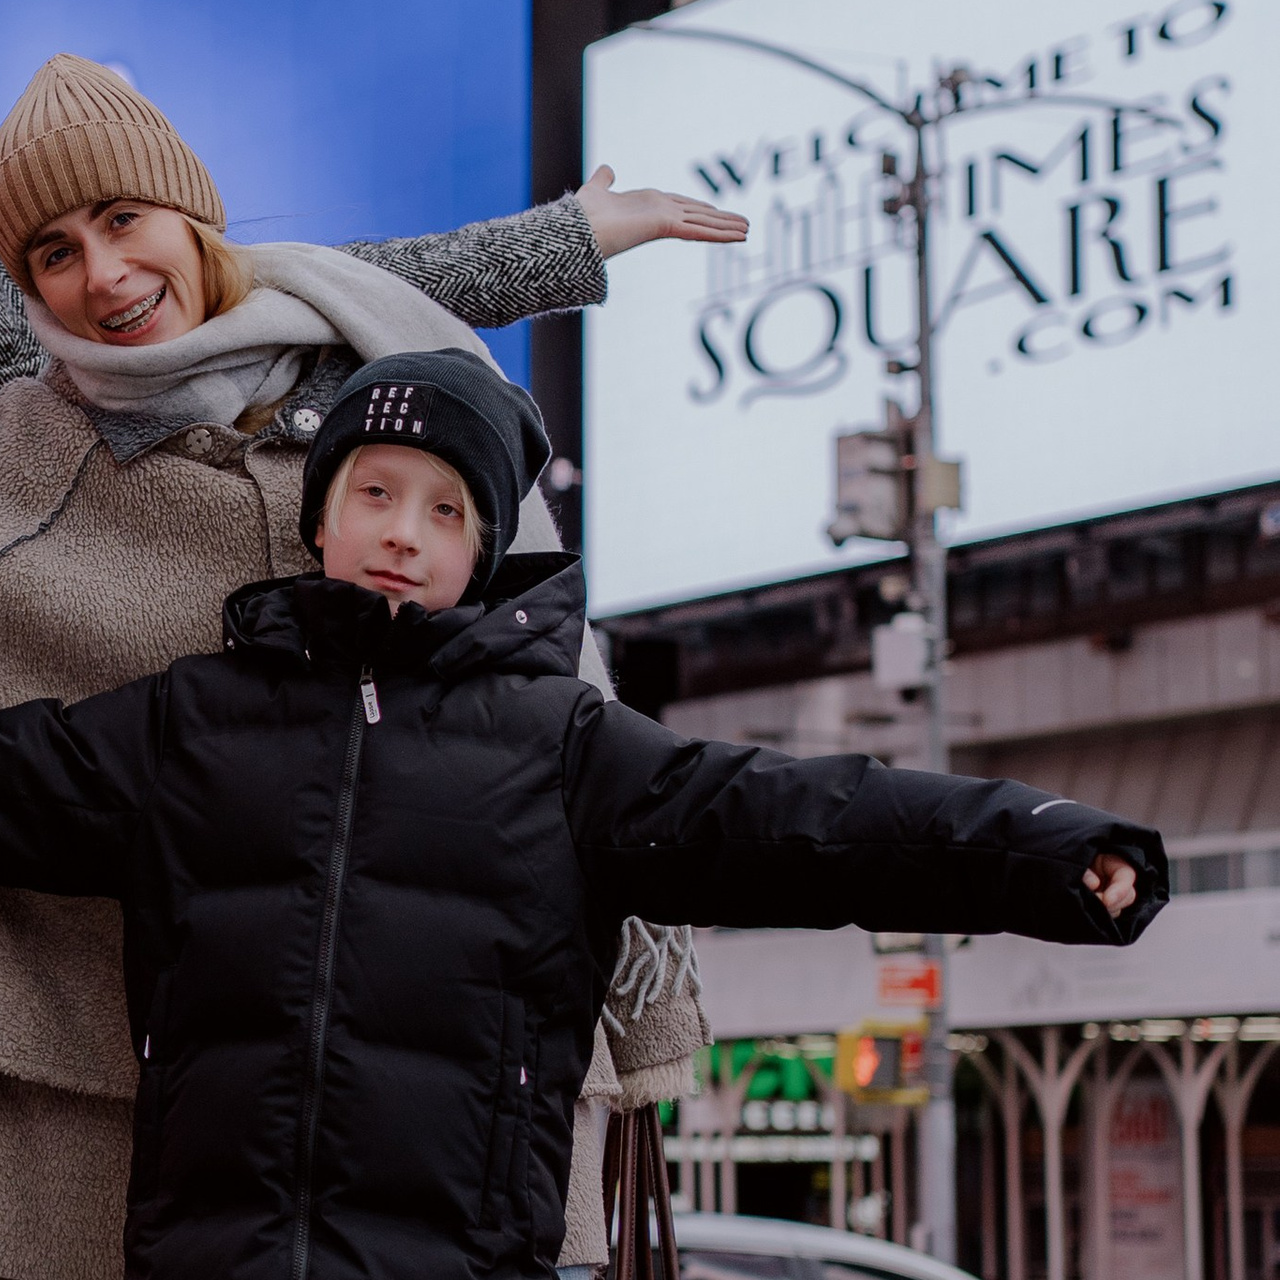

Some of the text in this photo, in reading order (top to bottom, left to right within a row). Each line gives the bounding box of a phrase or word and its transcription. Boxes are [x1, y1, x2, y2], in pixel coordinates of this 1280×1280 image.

[925, 72, 1232, 222] IMES
[686, 152, 1234, 410] SQUARE
[986, 272, 1235, 376] .COM
[367, 401, 409, 415] LEC
[371, 387, 414, 400] REF
[364, 417, 422, 434] TION
